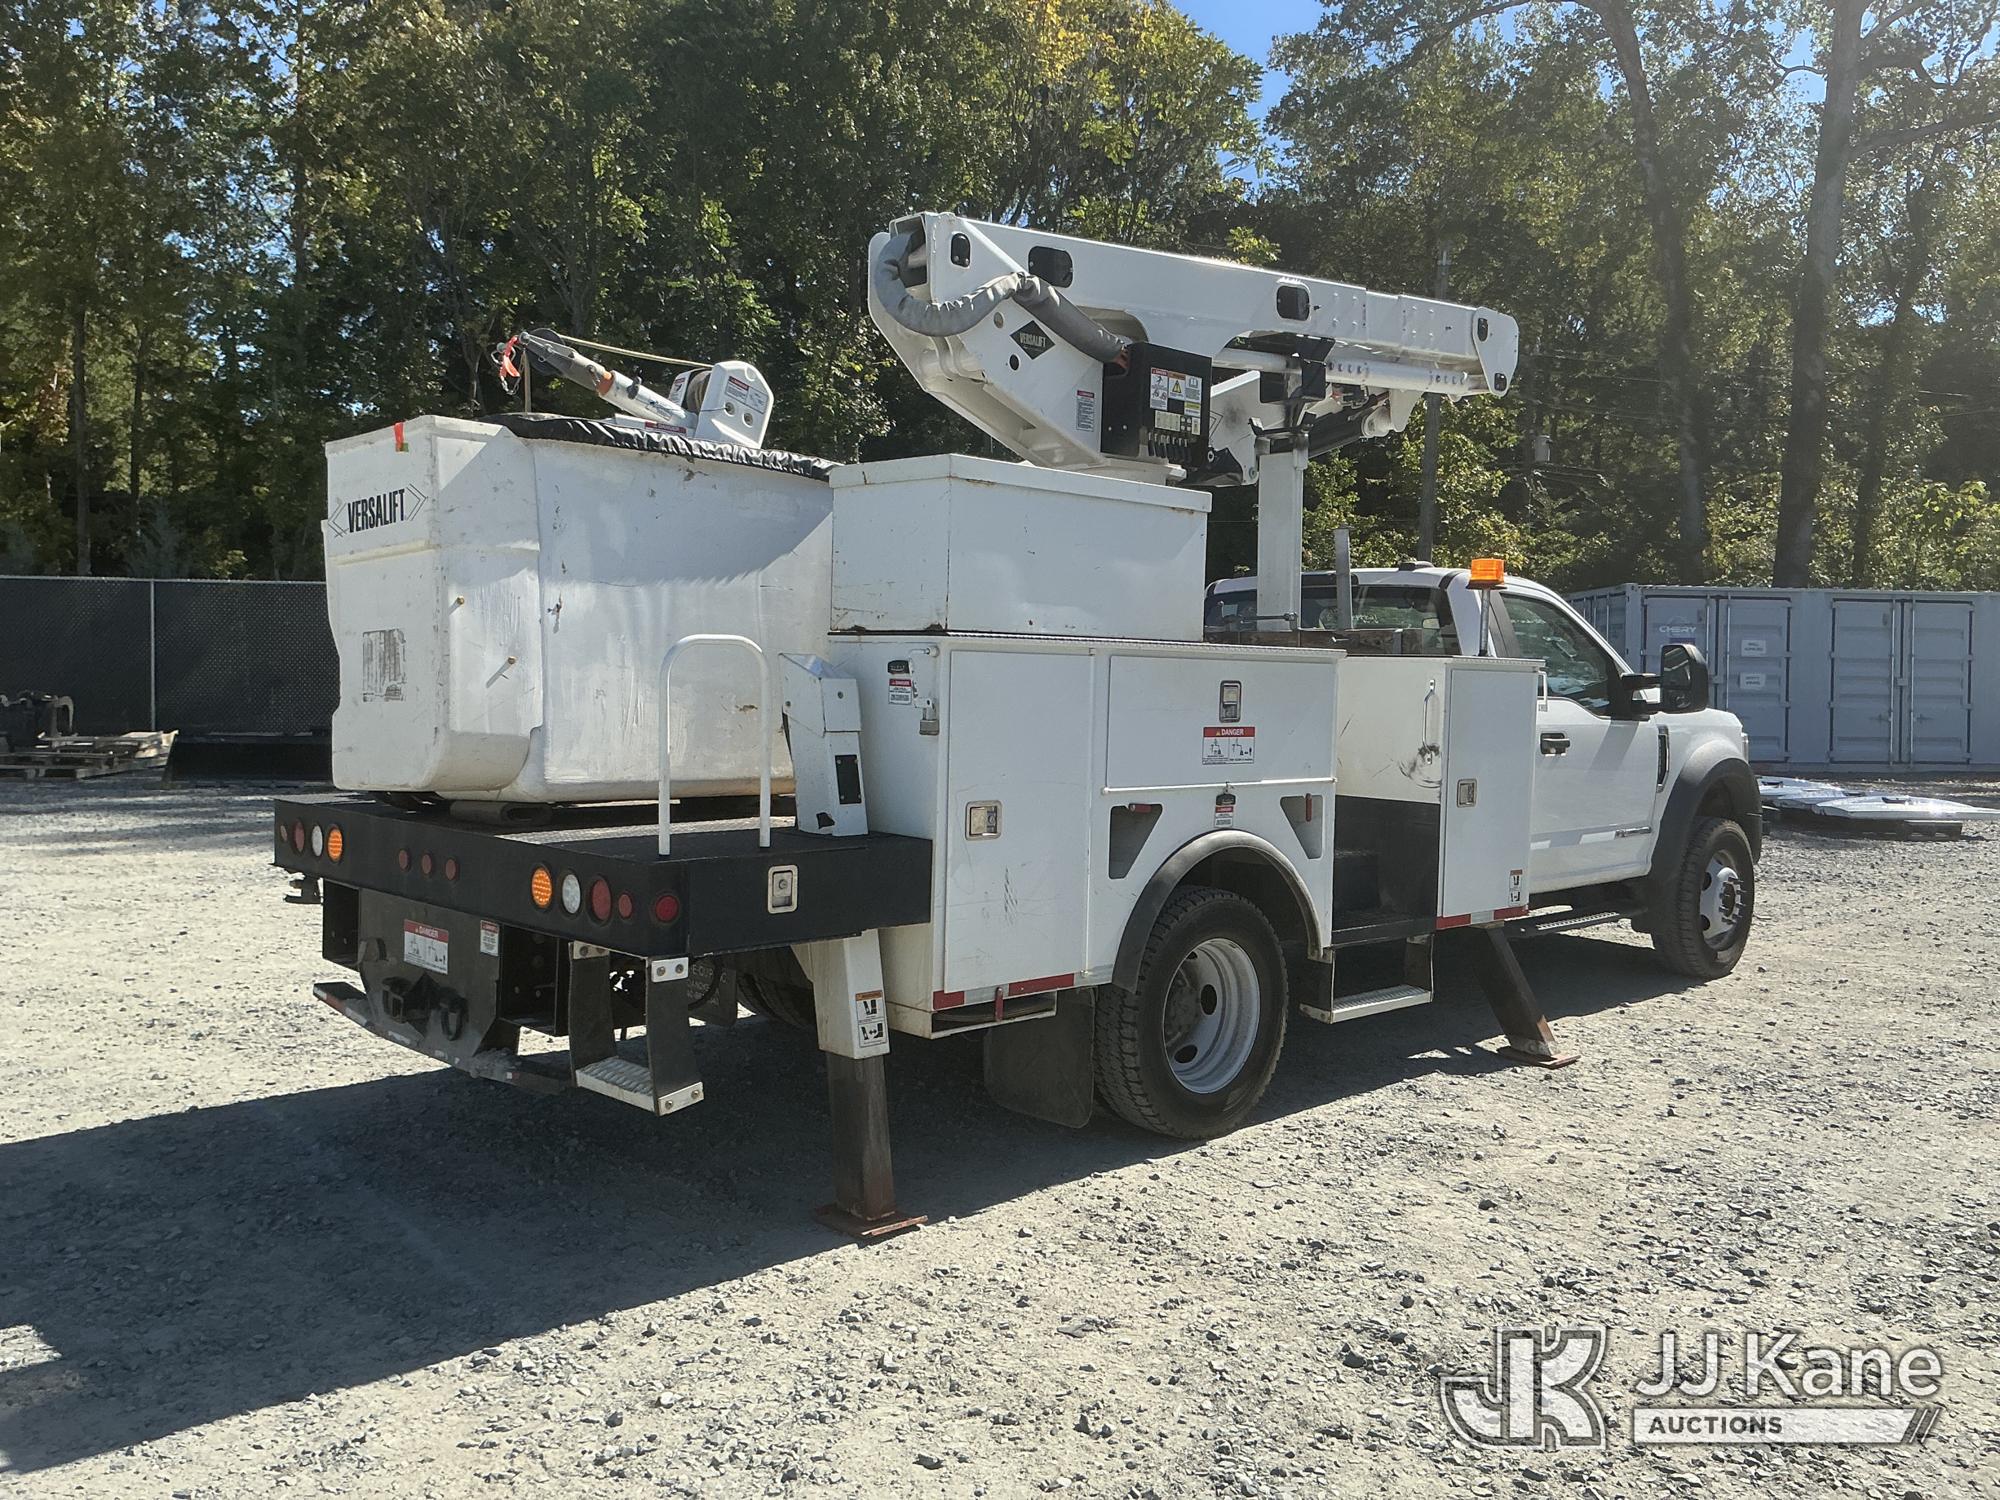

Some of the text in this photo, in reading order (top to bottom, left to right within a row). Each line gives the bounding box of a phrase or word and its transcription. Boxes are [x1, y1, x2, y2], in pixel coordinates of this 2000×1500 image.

[347, 488, 406, 533] VERSALIFT
[1659, 625, 1697, 634] CHERY
[1221, 728, 1245, 736] DANGER
